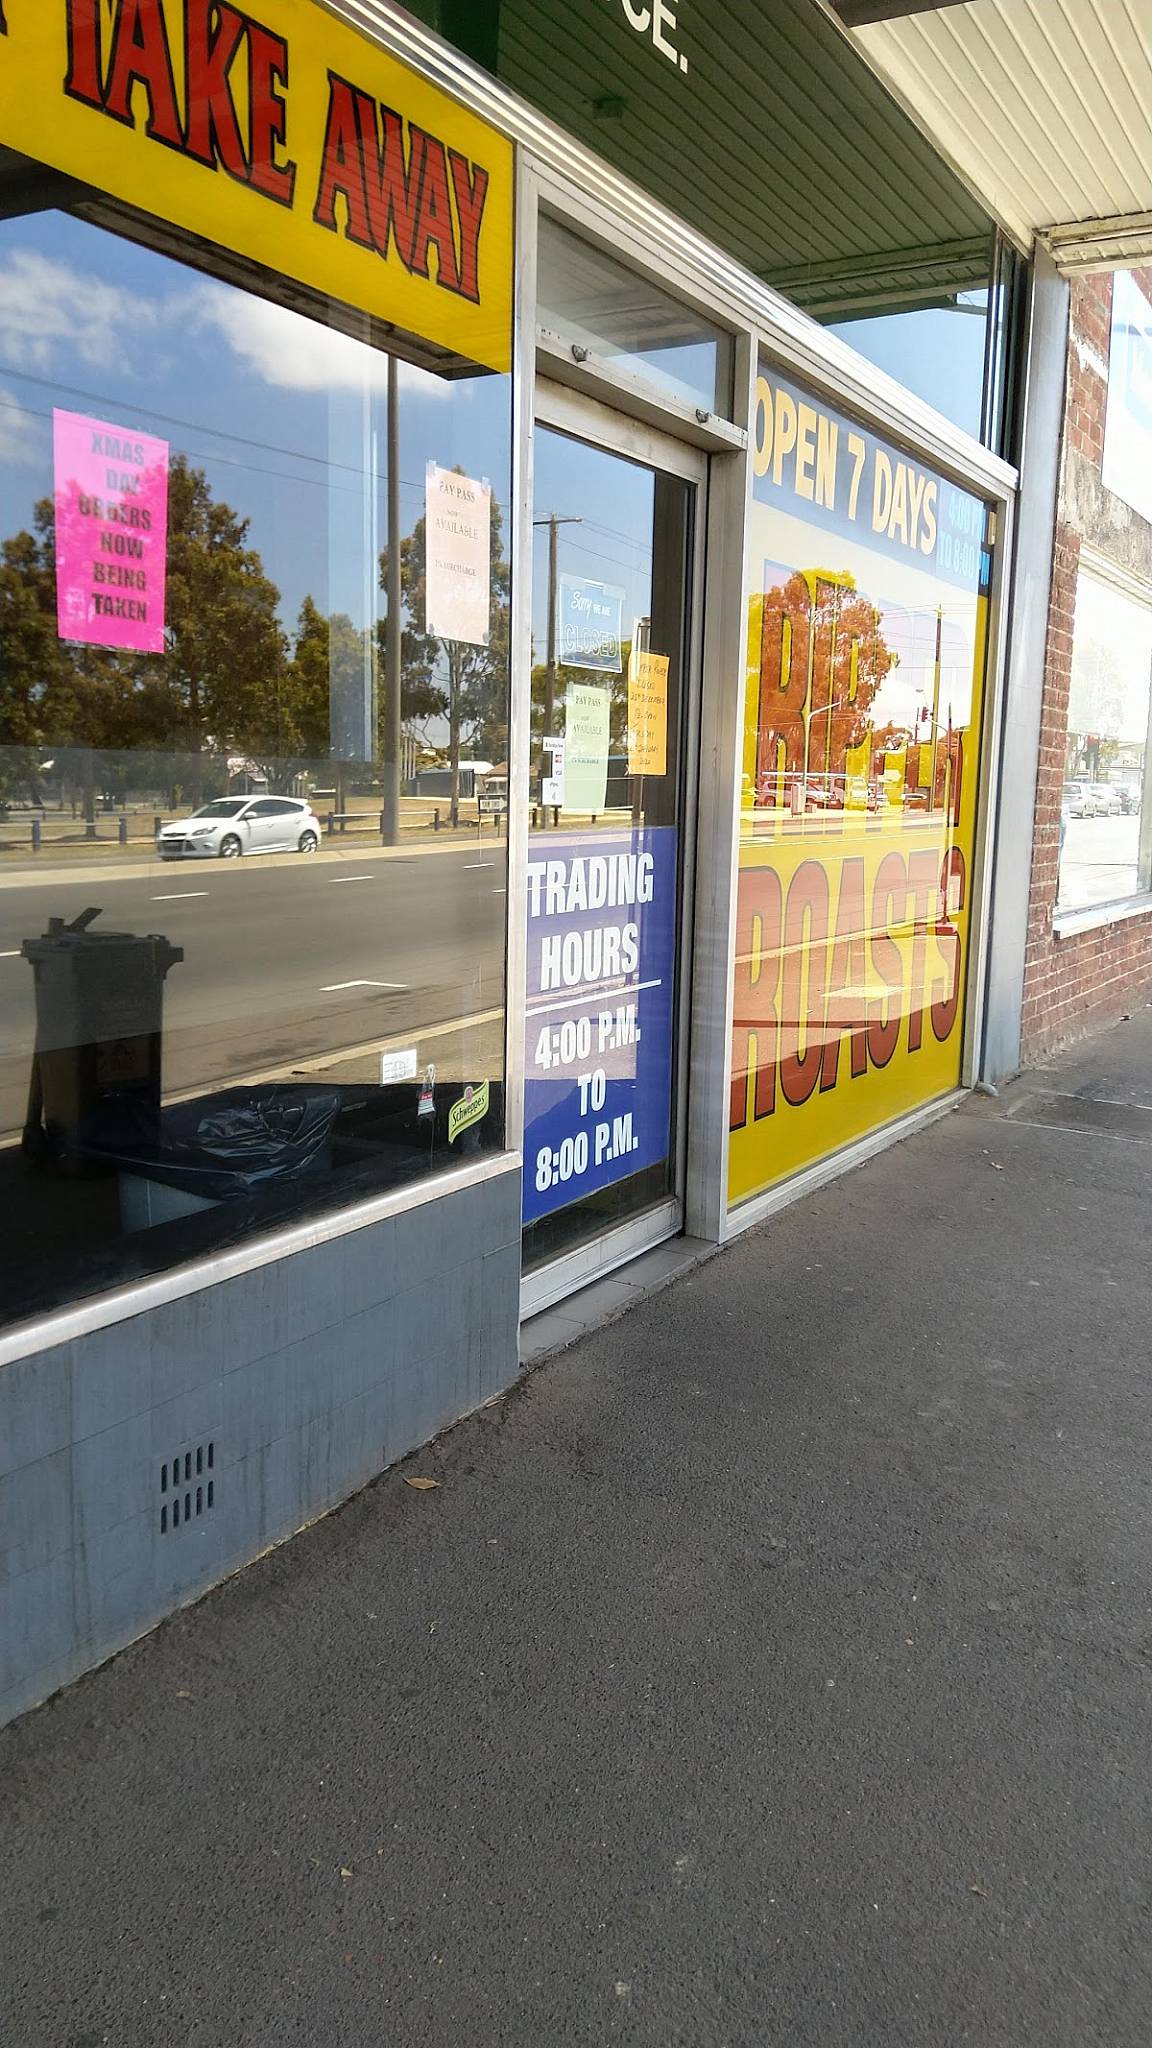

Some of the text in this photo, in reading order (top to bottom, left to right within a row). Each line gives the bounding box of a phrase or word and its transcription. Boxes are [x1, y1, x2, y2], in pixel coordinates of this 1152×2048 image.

[312, 67, 489, 306] AWAY
[91, 432, 145, 466] XMAS
[753, 376, 938, 556] OPEN 7 DAYS
[106, 468, 140, 496] DAY
[439, 480, 476, 504] PAY PASS
[78, 495, 152, 531] ORDERS
[434, 518, 479, 541] AVAILABLE
[101, 532, 144, 560] NOW
[93, 561, 146, 592] BEING
[91, 592, 147, 623] TAKEN
[570, 591, 592, 619] Sorry
[564, 623, 617, 658] CLOSED
[527, 852, 654, 918] TRADING
[539, 922, 640, 992] HOURS
[729, 845, 966, 1133] ROASTS
[534, 1003, 641, 1071] 4:00 P.M.
[577, 1068, 607, 1117] TO
[452, 1094, 485, 1127] Schweppes
[535, 1112, 639, 1193] 8:00 P.M.
